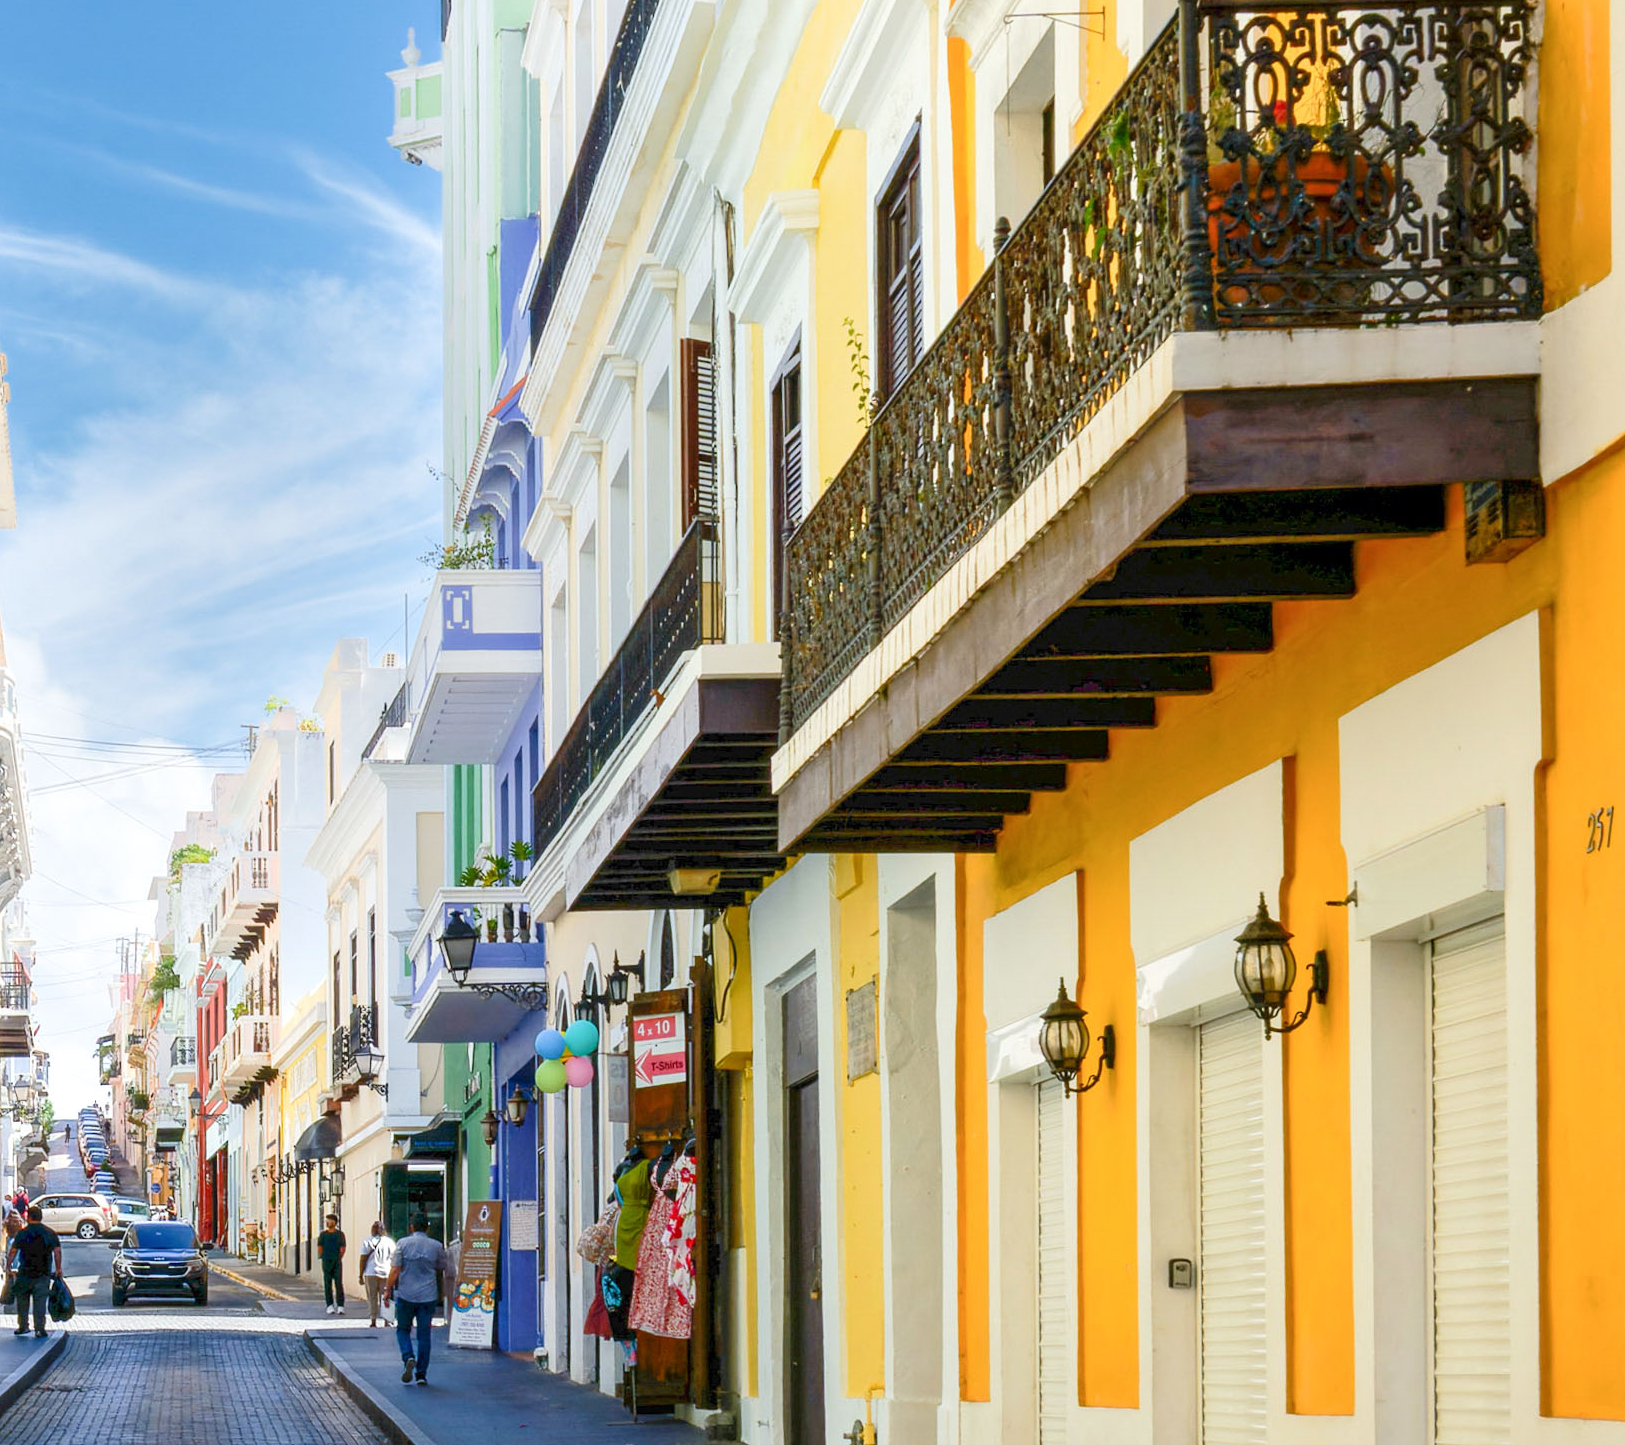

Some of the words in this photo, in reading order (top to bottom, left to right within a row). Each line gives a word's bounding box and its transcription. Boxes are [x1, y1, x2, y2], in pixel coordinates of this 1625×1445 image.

[637, 1023, 645, 1037] 4
[655, 1020, 670, 1034] 10
[651, 1059, 684, 1072] T-Shirts
